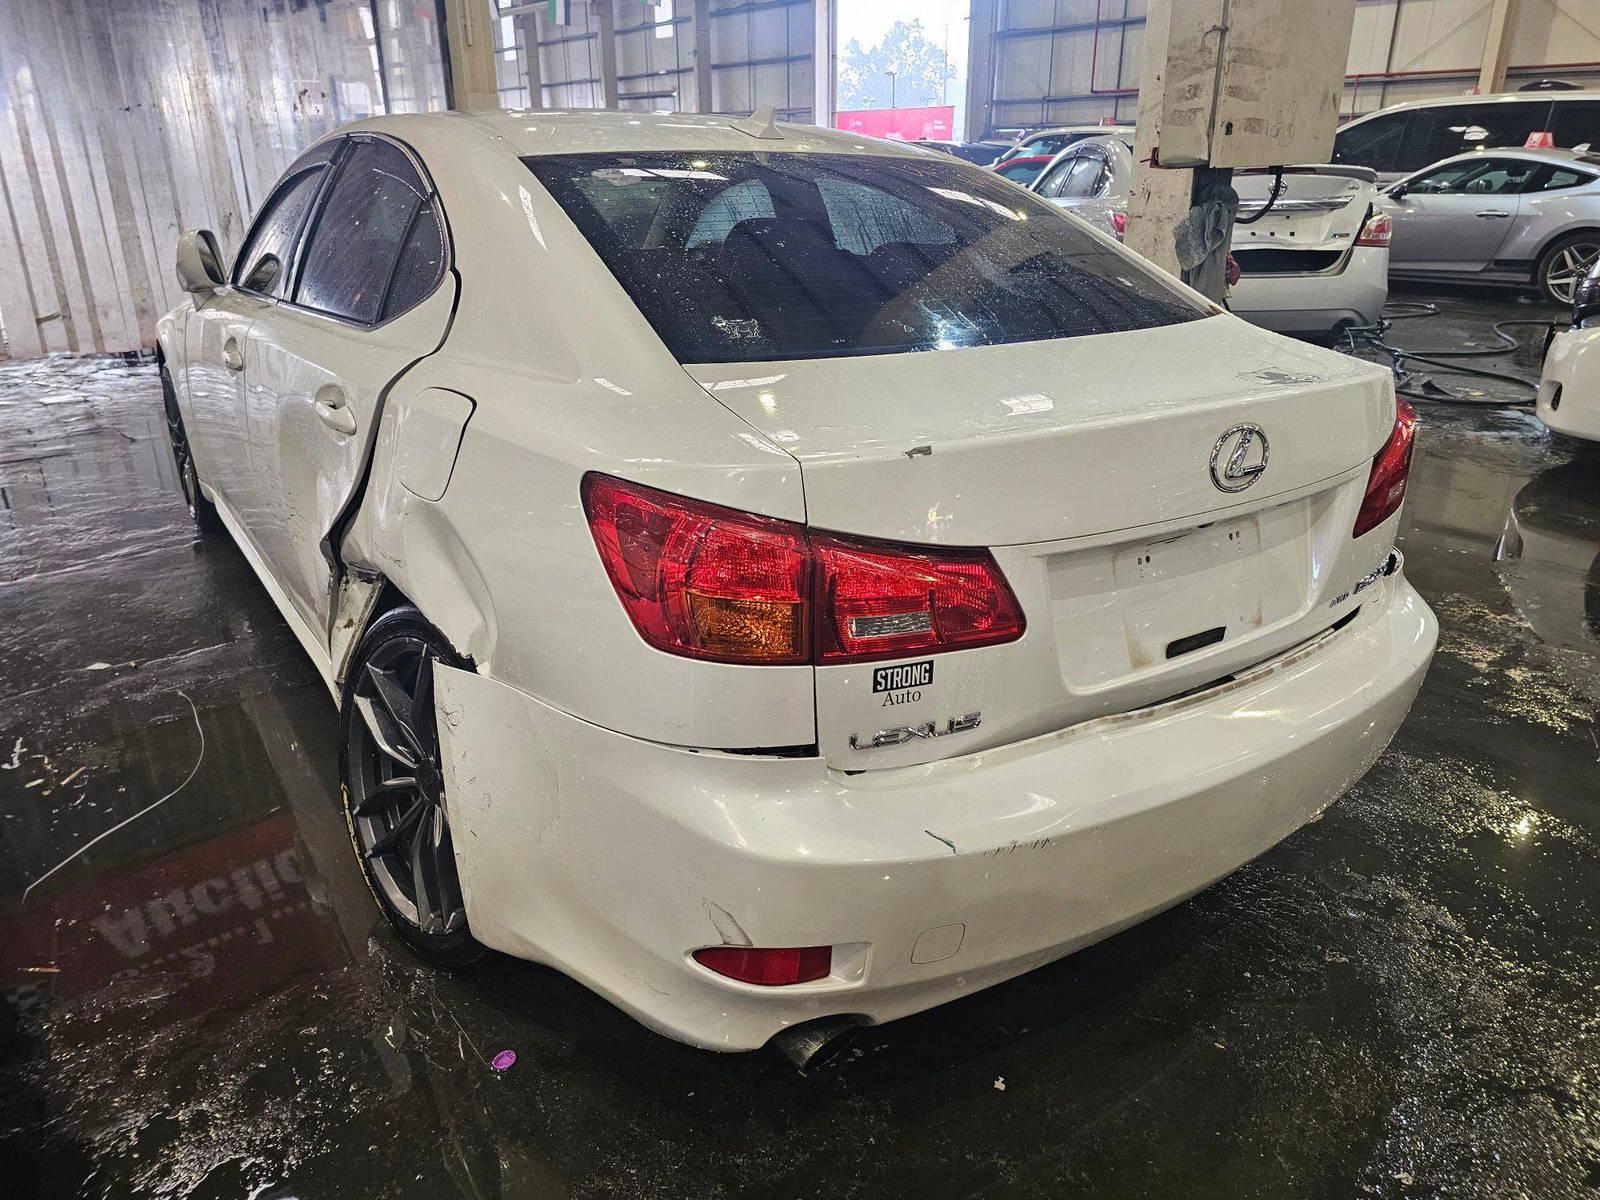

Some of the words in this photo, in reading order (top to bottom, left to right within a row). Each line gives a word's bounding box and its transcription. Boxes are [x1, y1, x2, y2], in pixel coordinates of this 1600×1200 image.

[876, 662, 930, 692] STRONG
[881, 689, 922, 707] Auto
[849, 711, 982, 750] LEXUS
